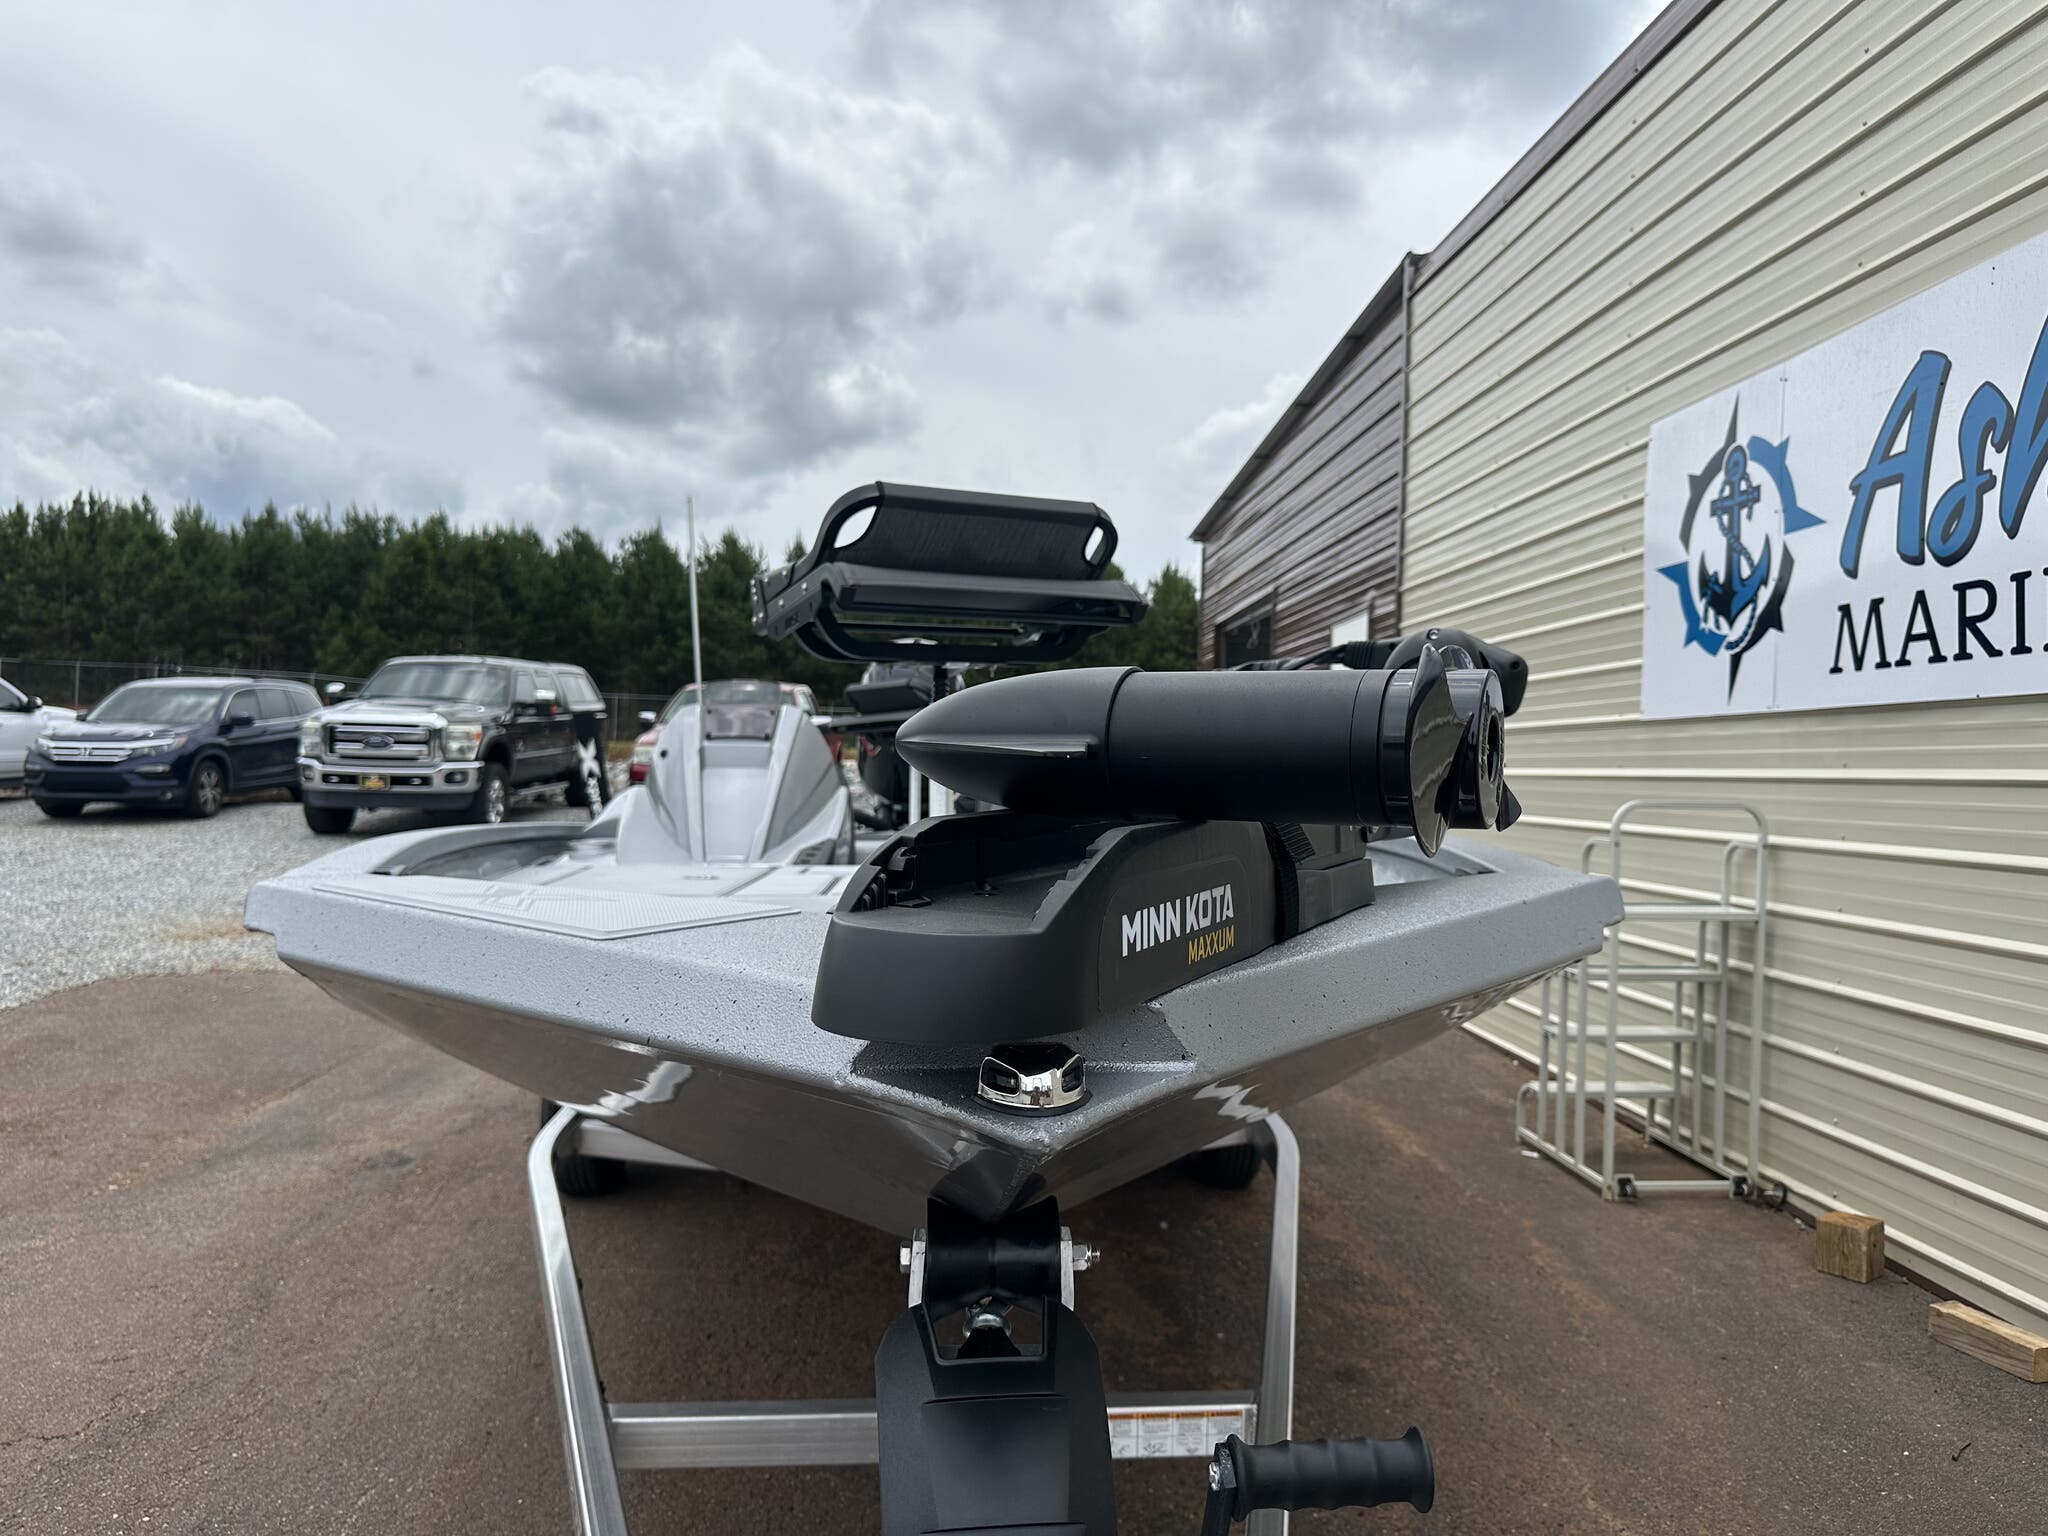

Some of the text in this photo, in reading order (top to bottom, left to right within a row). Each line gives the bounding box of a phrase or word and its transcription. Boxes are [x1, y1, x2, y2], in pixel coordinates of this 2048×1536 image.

[1829, 567, 2048, 674] MARI
[1122, 883, 1234, 957] MINN KOTA
[1188, 925, 1235, 965] MAXXUM
